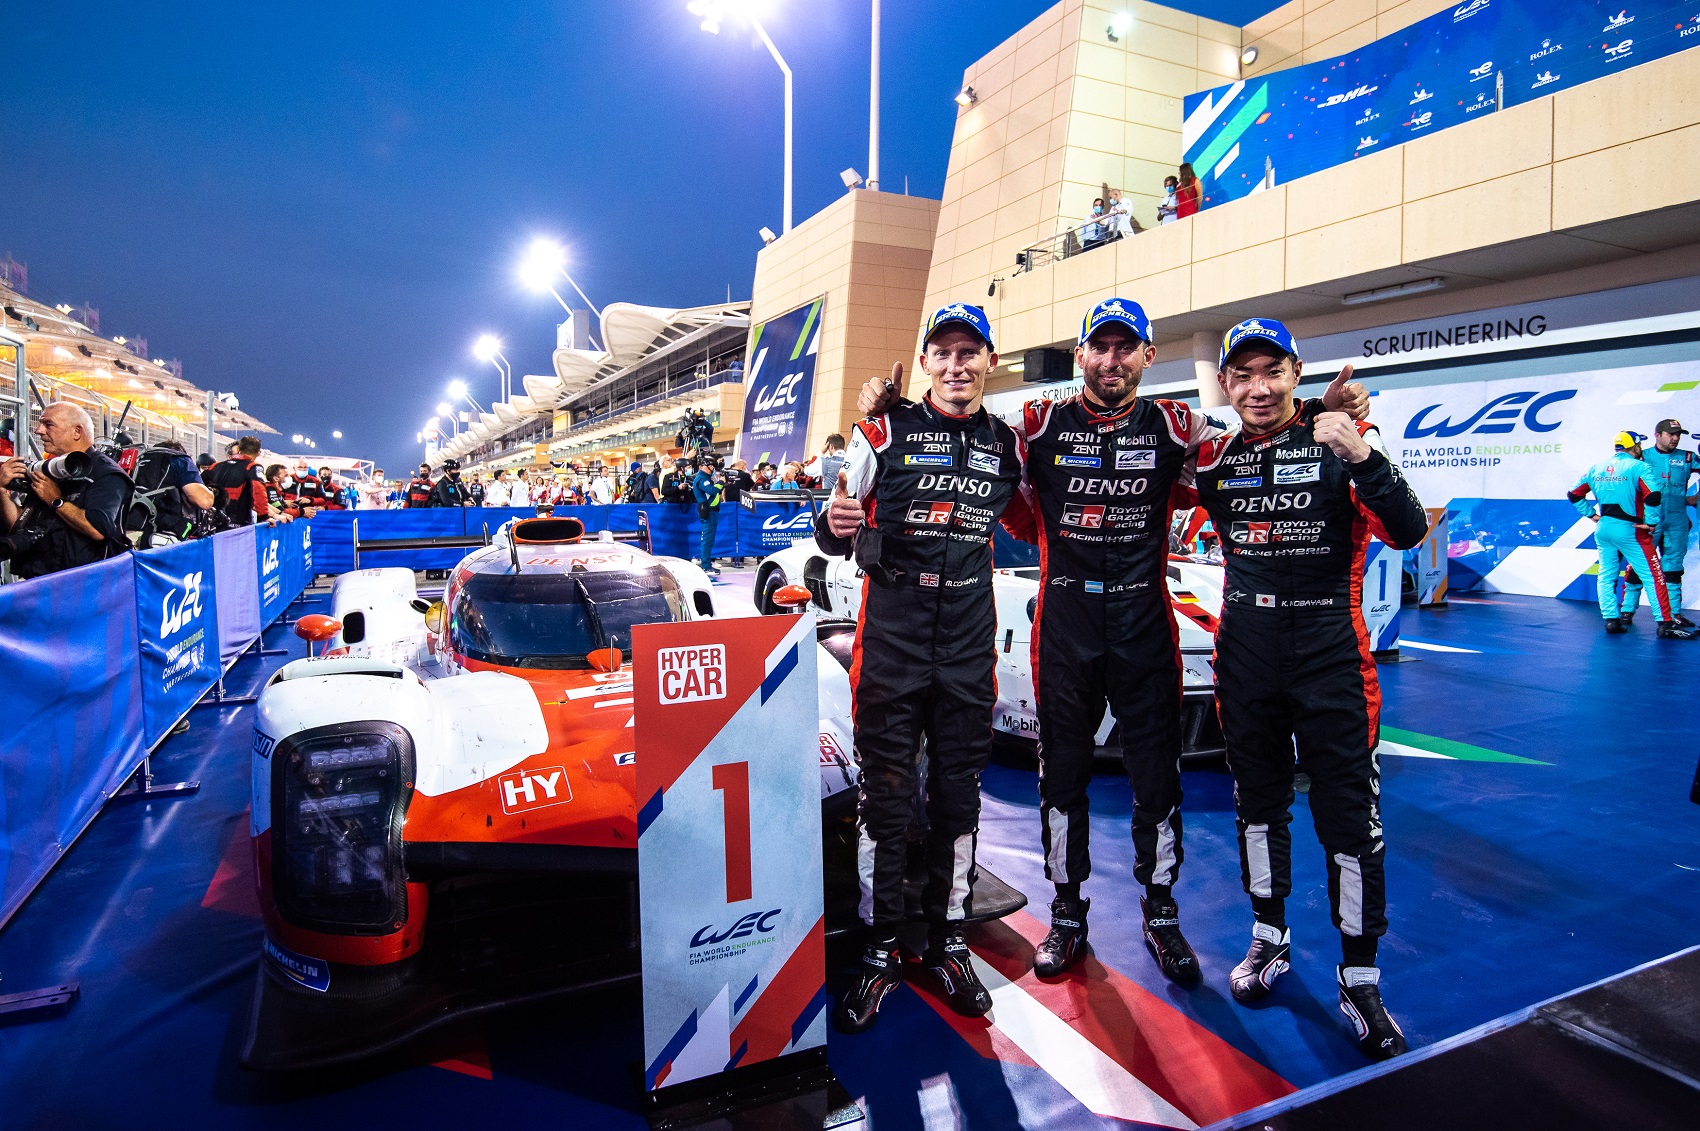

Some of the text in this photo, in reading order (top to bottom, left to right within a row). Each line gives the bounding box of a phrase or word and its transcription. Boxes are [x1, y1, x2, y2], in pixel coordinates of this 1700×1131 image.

[1530, 44, 1562, 61] ROLEX
[1322, 85, 1374, 107] DHL
[1466, 98, 1495, 113] ROLEX
[1363, 314, 1547, 358] SCRUTINEERING
[754, 372, 804, 412] WEC
[1403, 389, 1578, 439] WEC
[906, 432, 950, 442] AISIN
[1117, 435, 1145, 446] Mobil
[923, 443, 952, 453] ZENT
[1072, 445, 1102, 455] ZENT
[1276, 448, 1308, 459] Mobil
[1403, 443, 1562, 458] FIA WORLD ENDURANCE
[1234, 464, 1262, 476] ZENT
[1277, 464, 1317, 476] WEC
[1402, 458, 1501, 469] CHAMPIONSHIP
[917, 473, 992, 497] DENSO
[1067, 477, 1148, 496] DENSO
[960, 503, 994, 516] TOYOTA
[1108, 505, 1151, 514] TOYOTA
[1230, 491, 1312, 513] DENSO
[763, 512, 815, 530] WE
[956, 510, 991, 523] GAZOO
[1107, 513, 1147, 522] GAZOO
[904, 529, 947, 537] RACING
[1059, 530, 1103, 542] RACING
[1271, 534, 1320, 543] Racing
[1272, 527, 1321, 535] GAZOO
[263, 540, 279, 577] WEC
[1275, 546, 1331, 557] HYBRID
[1430, 538, 1437, 568] 1
[1379, 560, 1387, 601] 1
[160, 571, 203, 639] WEC
[661, 647, 722, 670] HYPER
[662, 667, 723, 700] CAR
[504, 771, 561, 807] HY
[712, 760, 753, 904] 1
[689, 908, 782, 949] WEC
[689, 936, 776, 960] FIA WORLD ENDURANCE
[269, 943, 318, 978] MICHELIN
[689, 949, 747, 966] CHAMPIONSHIP
